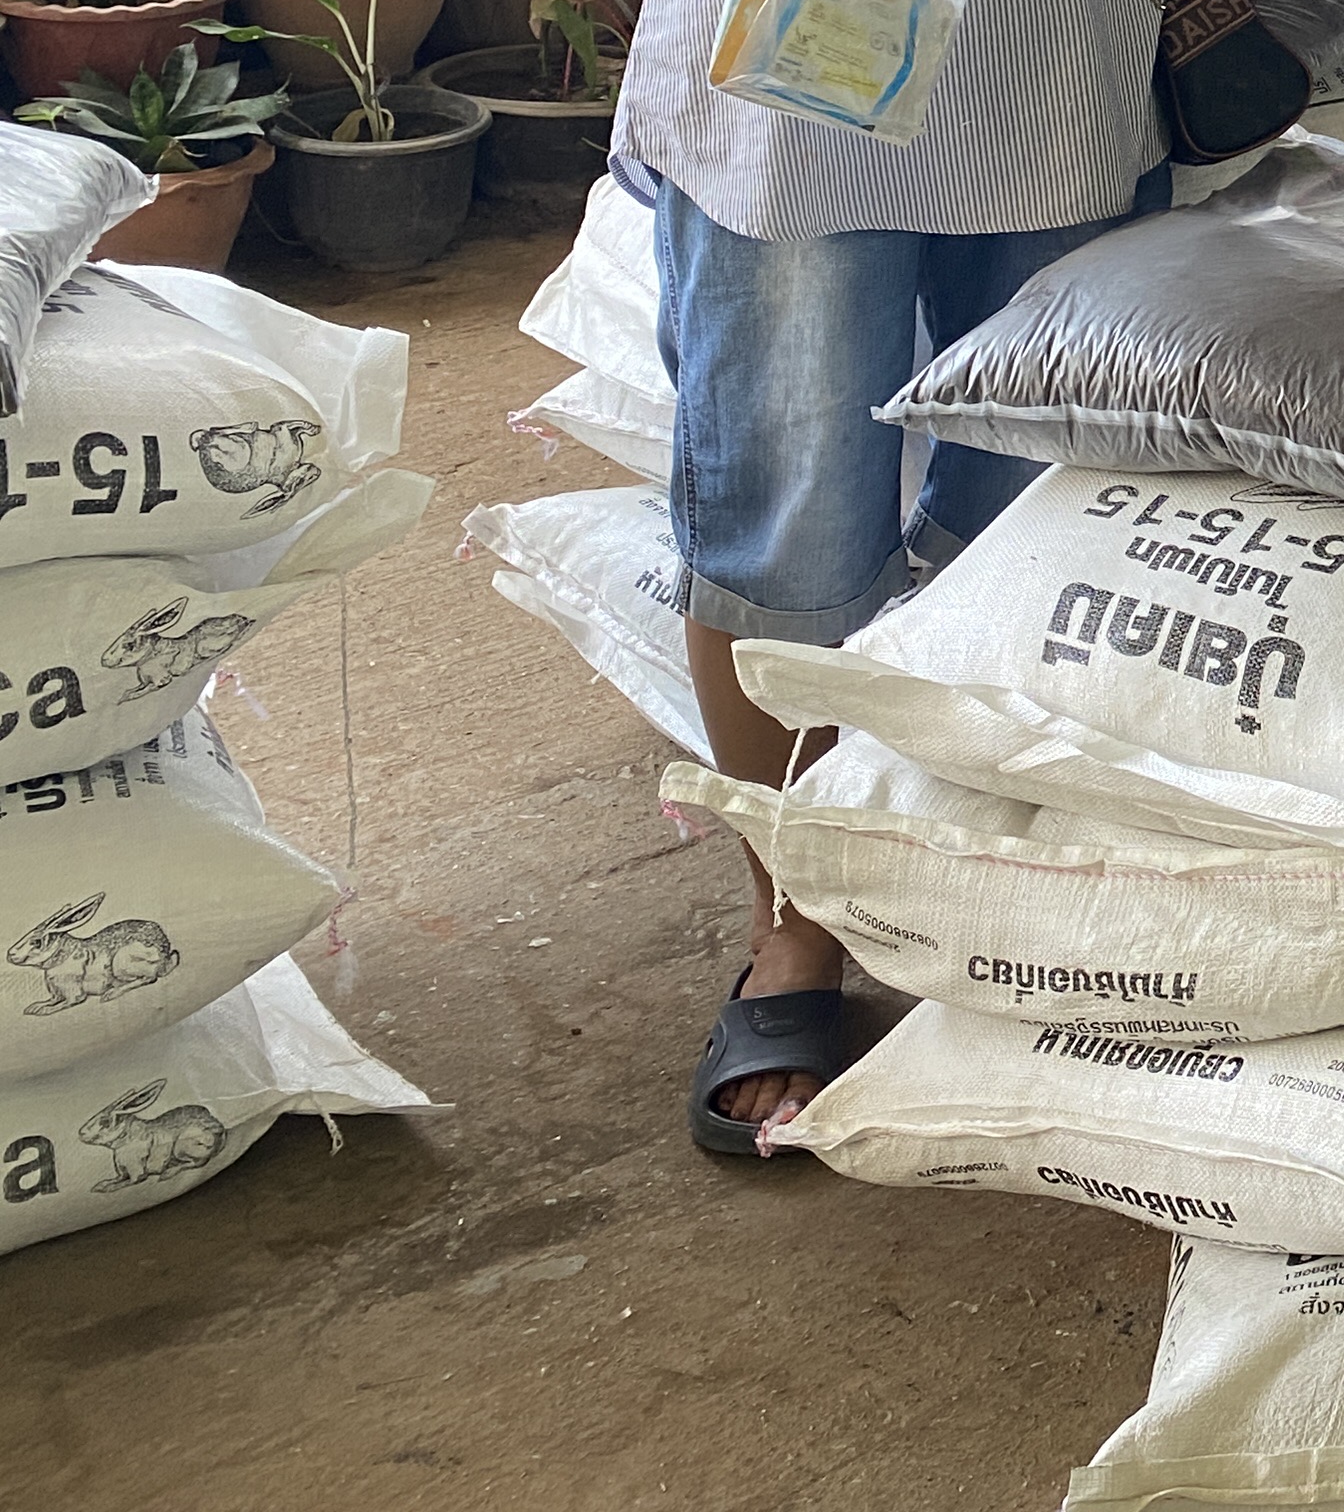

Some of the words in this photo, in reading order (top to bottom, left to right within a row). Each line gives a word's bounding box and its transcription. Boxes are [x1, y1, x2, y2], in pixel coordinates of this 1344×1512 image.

[1041, 581, 1307, 736] ปุ๋ยเคมี
[967, 955, 1198, 1006] ห้ามใช้ขอเกี่ยว
[1036, 1164, 1239, 1230] ห้ามใช้ขอเกี่ยว
